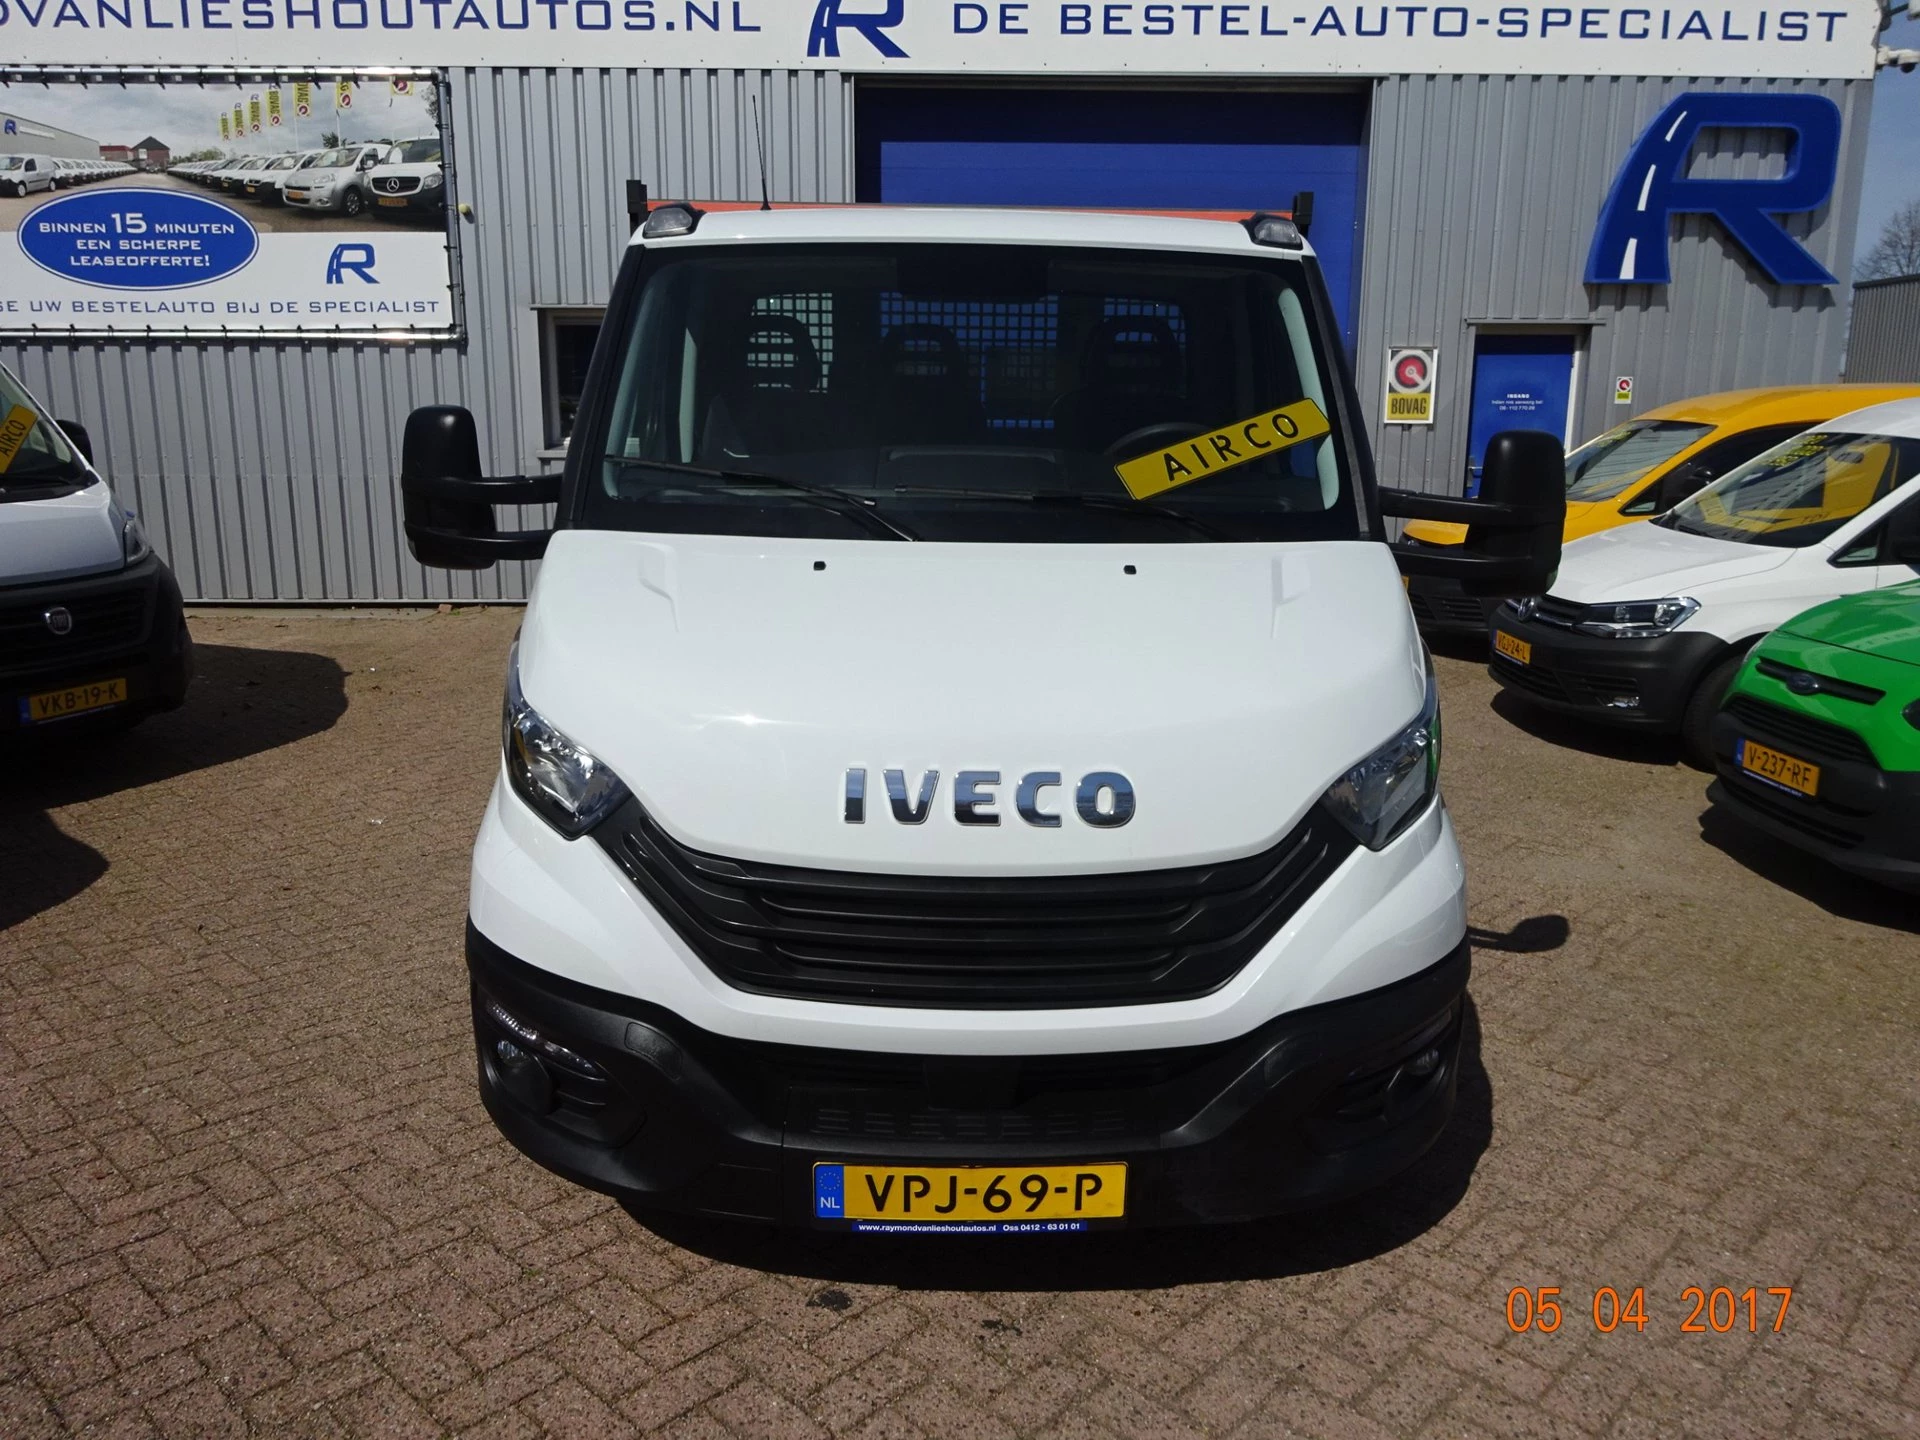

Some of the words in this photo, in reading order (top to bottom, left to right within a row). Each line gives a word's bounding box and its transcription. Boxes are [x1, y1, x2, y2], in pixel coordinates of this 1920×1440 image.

[953, 3, 1029, 34] DE
[1060, 4, 1848, 42] BESTEL-AUTO-SPECIALIST
[39, 222, 106, 233] BINNEN
[111, 212, 148, 234] 15
[155, 223, 235, 234] MINUTEN
[76, 239, 111, 250] EEN
[119, 239, 201, 250] SCHERPE
[70, 254, 210, 267] LEASEOFFERTE!
[30, 301, 61, 312] UW
[72, 301, 215, 313] BESTELAUTO
[226, 301, 260, 313] BIJ
[270, 301, 299, 313] DE
[309, 301, 439, 313] SPECIALIST
[1391, 397, 1427, 415] BOVAG
[0, 420, 26, 457] AIRCO
[1163, 413, 1299, 481] AIRCO
[39, 683, 118, 714] VKB-19-K
[1749, 746, 1811, 787] V-237-RF
[843, 767, 1137, 827] IVECO
[820, 1196, 840, 1209] NL
[865, 1173, 1103, 1214] VPJ-69-P
[858, 1224, 996, 1232] www.raymondvanlieshoutautos.nl
